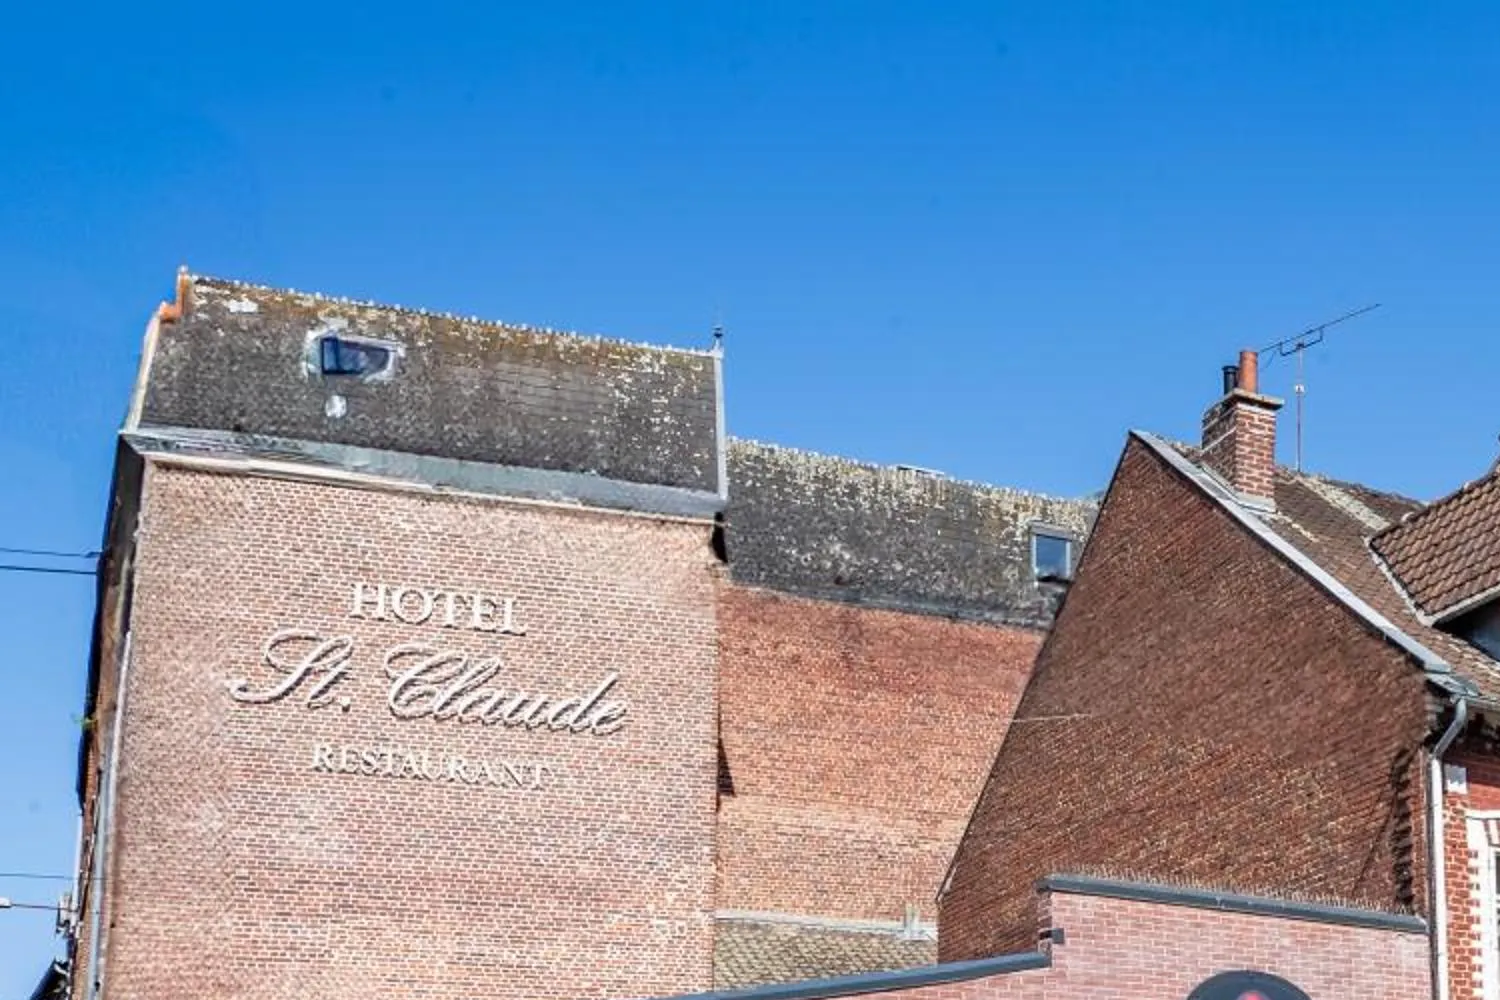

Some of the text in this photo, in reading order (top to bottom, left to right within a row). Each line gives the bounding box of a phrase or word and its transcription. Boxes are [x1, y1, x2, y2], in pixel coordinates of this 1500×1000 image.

[350, 583, 527, 635] HOTEL
[384, 642, 628, 737] Claude
[312, 742, 557, 791] RESTAURANT
